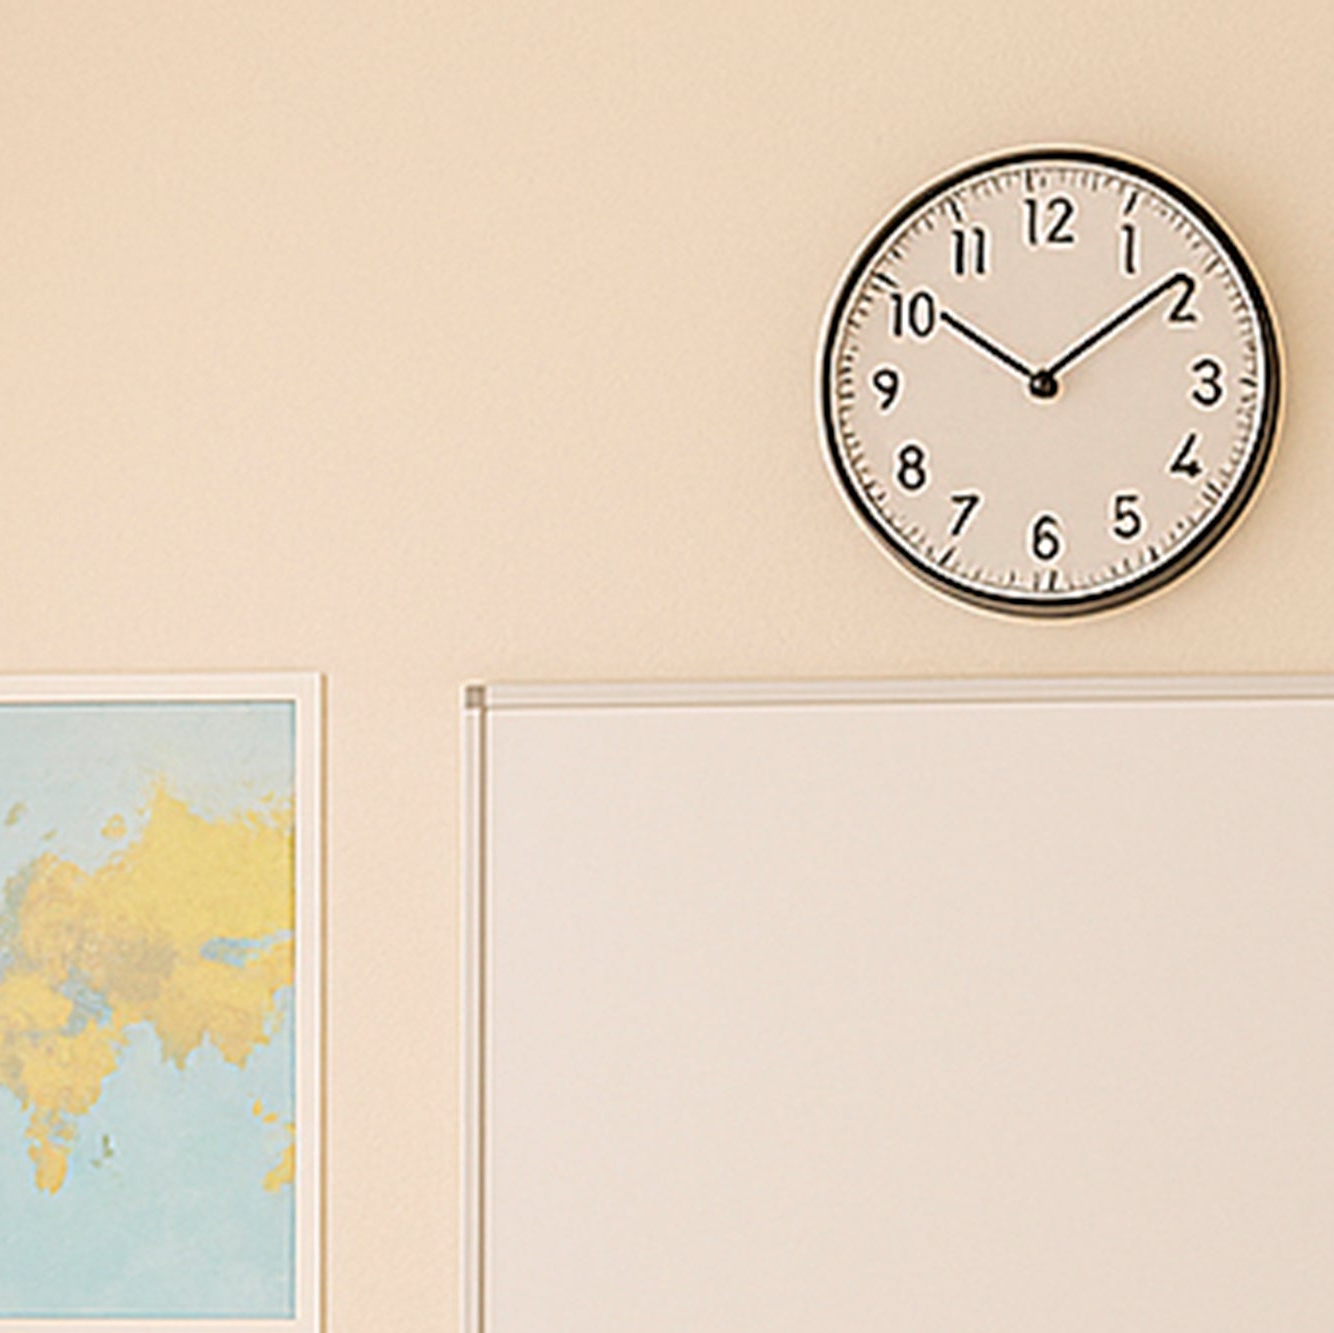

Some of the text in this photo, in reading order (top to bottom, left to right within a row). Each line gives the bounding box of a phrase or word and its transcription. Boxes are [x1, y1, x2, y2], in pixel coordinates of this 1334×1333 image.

[1024, 196, 1075, 246] 12
[951, 226, 986, 276] 11
[1121, 223, 1136, 275] 1
[889, 290, 936, 338] 10
[1165, 272, 1197, 323] 2
[872, 368, 900, 411] 9
[1191, 358, 1224, 407] 3
[896, 443, 927, 492] 8
[1169, 432, 1203, 479] 4
[950, 494, 980, 537] 7
[1032, 514, 1060, 562] 6
[1113, 494, 1142, 540] 5
